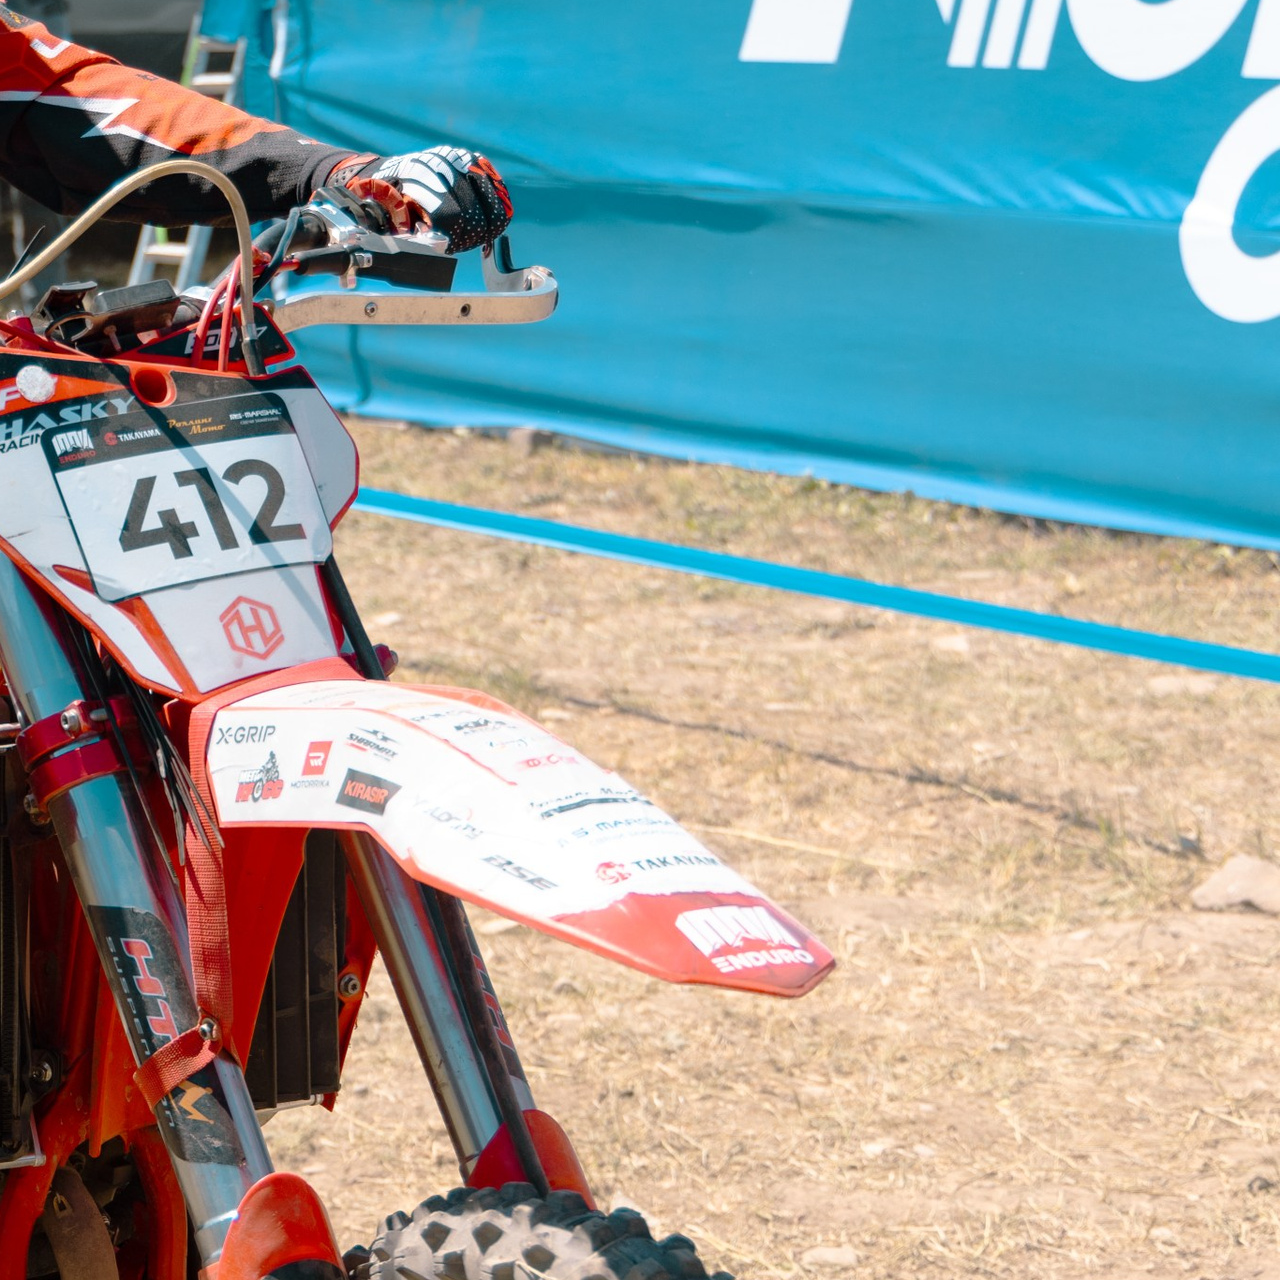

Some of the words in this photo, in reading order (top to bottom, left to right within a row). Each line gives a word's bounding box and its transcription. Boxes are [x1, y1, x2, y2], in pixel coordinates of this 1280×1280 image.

[116, 427, 161, 443] TAKAYAMA
[119, 458, 308, 561] 412
[215, 725, 277, 745] X-GRIP
[290, 779, 331, 789] MOTORRIKA
[344, 779, 389, 805] KIRASIR
[631, 854, 721, 871] TAKAYAM
[710, 948, 815, 974] ENDURO
